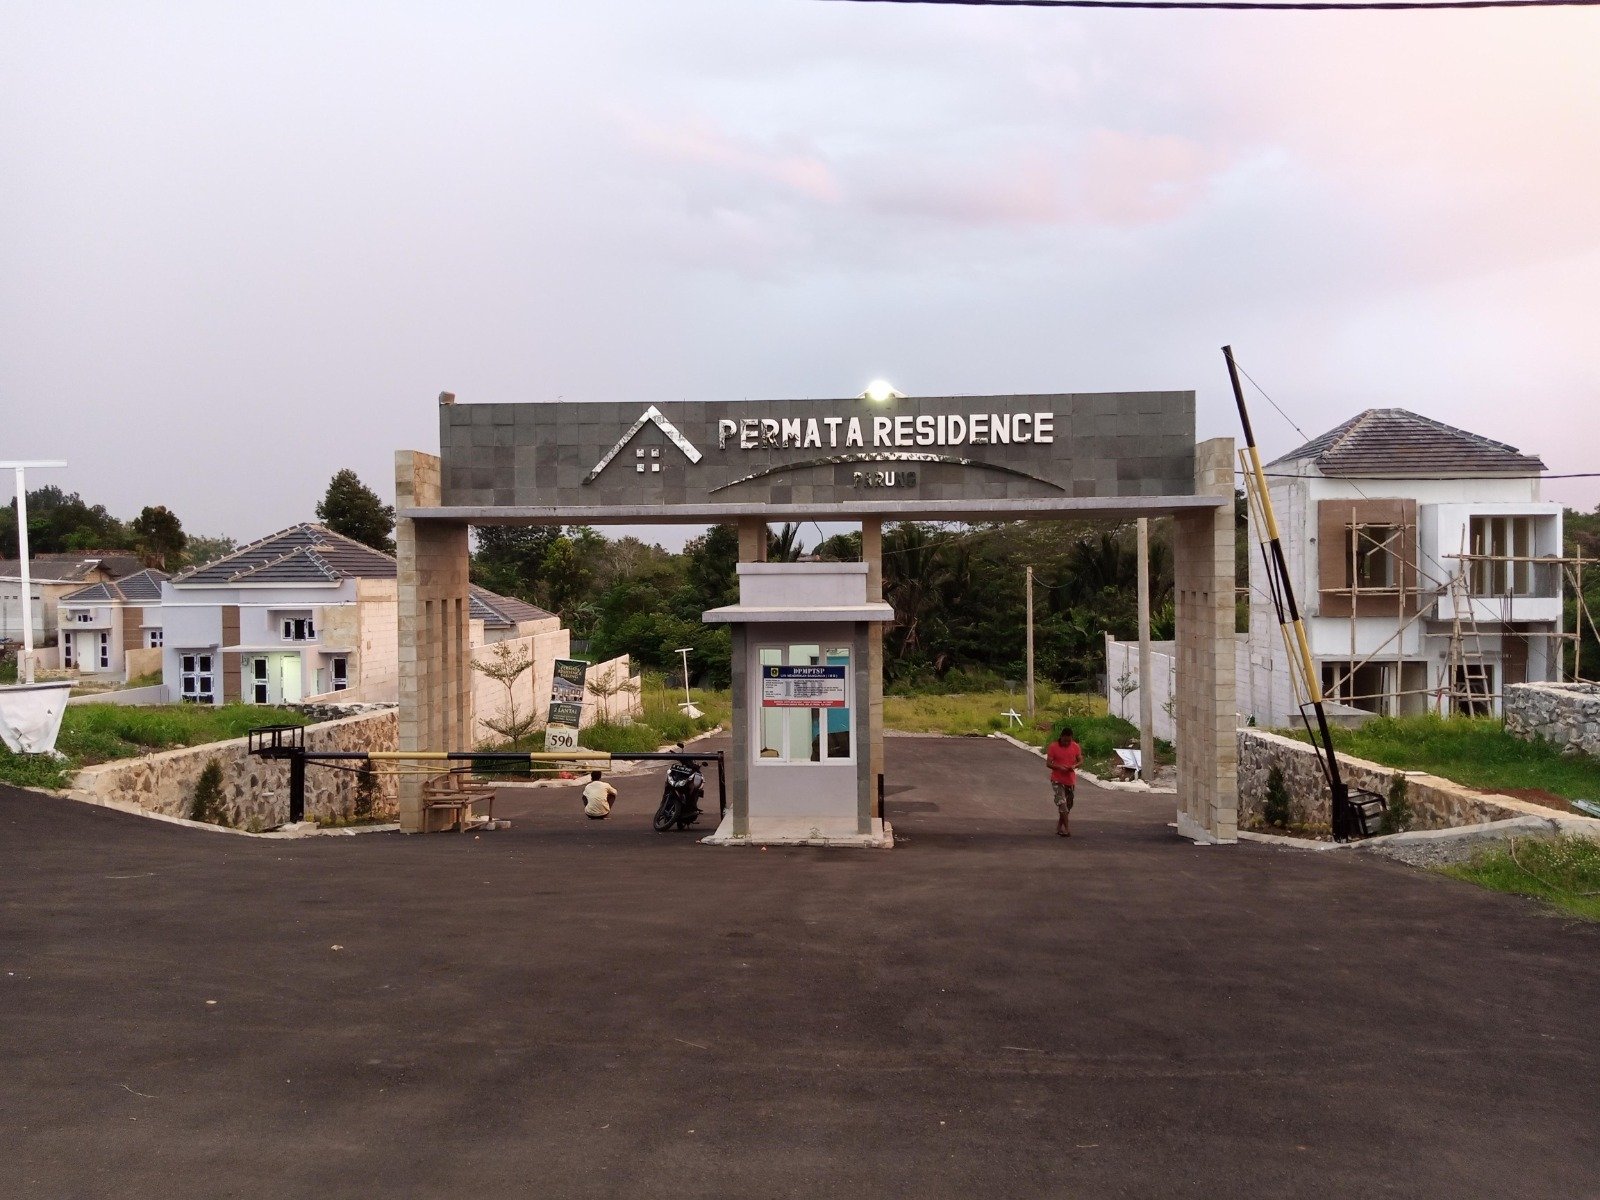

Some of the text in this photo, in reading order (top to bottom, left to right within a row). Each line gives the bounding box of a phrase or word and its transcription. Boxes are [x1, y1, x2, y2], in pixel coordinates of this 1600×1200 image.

[718, 412, 1054, 449] PERMATA RESIDENCE
[853, 471, 917, 488] PARUNG
[550, 734, 573, 748] 590
